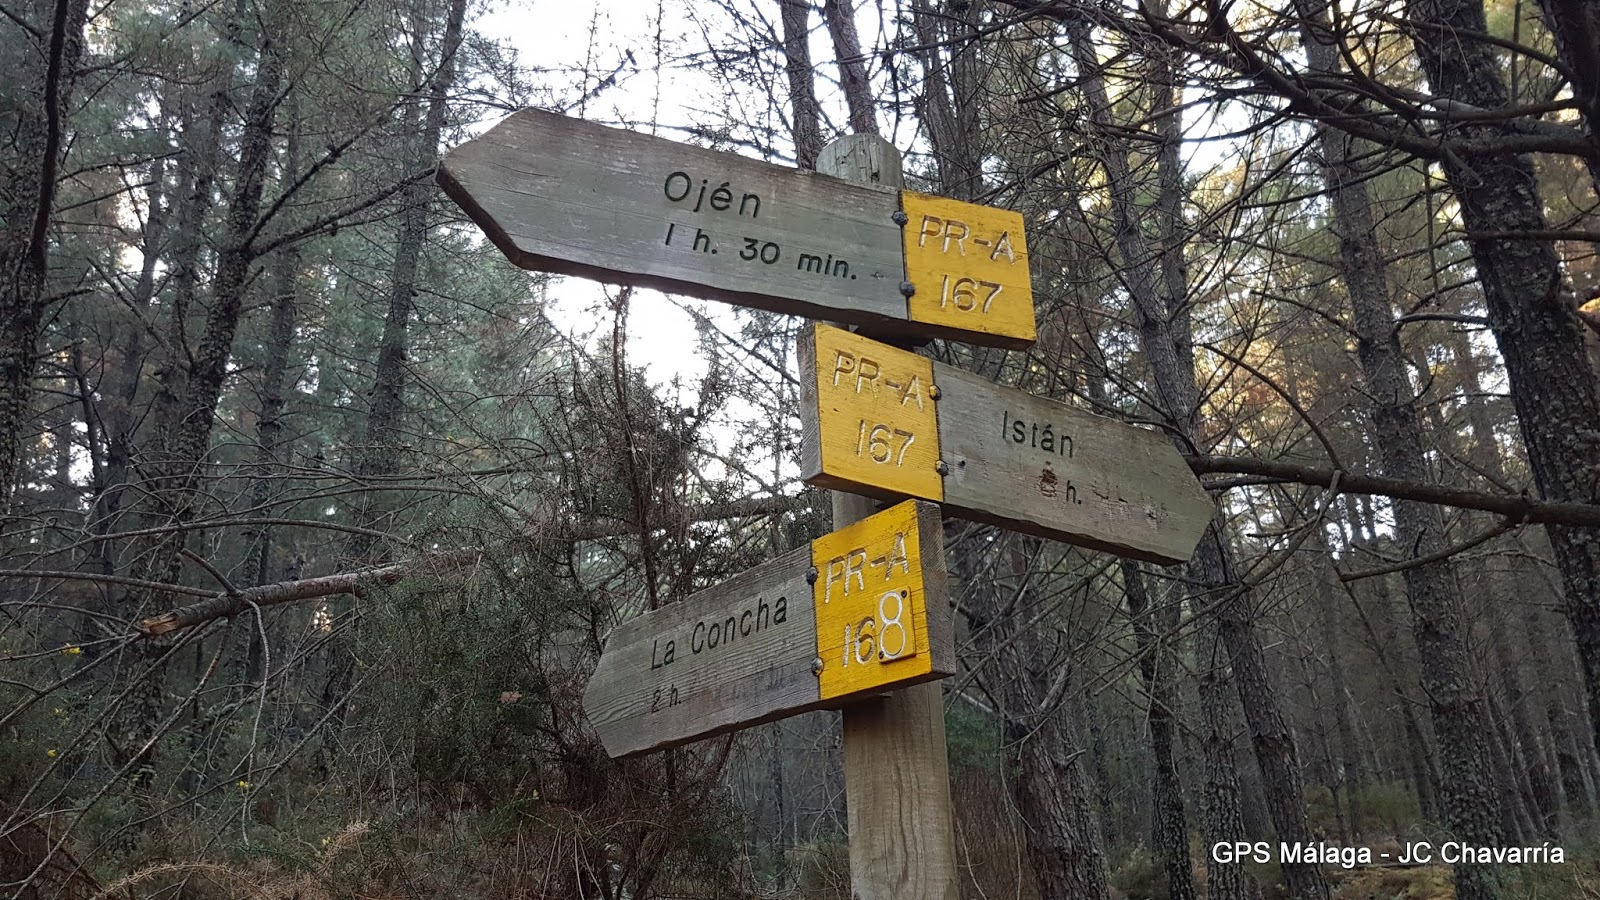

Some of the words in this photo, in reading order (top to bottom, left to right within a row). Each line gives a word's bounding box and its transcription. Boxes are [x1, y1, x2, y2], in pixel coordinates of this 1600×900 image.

[664, 171, 761, 219] Ojén
[692, 228, 718, 256] h.
[739, 237, 781, 266] 30
[797, 253, 858, 281] min.
[918, 214, 1016, 267] PR-A
[940, 273, 1004, 315] 167
[833, 349, 924, 411] PR-A
[856, 419, 915, 468] 167
[1001, 411, 1074, 458] Istán
[824, 531, 910, 605] PR-A
[651, 638, 676, 671] La
[691, 595, 789, 655] Concha
[842, 590, 907, 669] 168
[650, 689, 662, 714] 2
